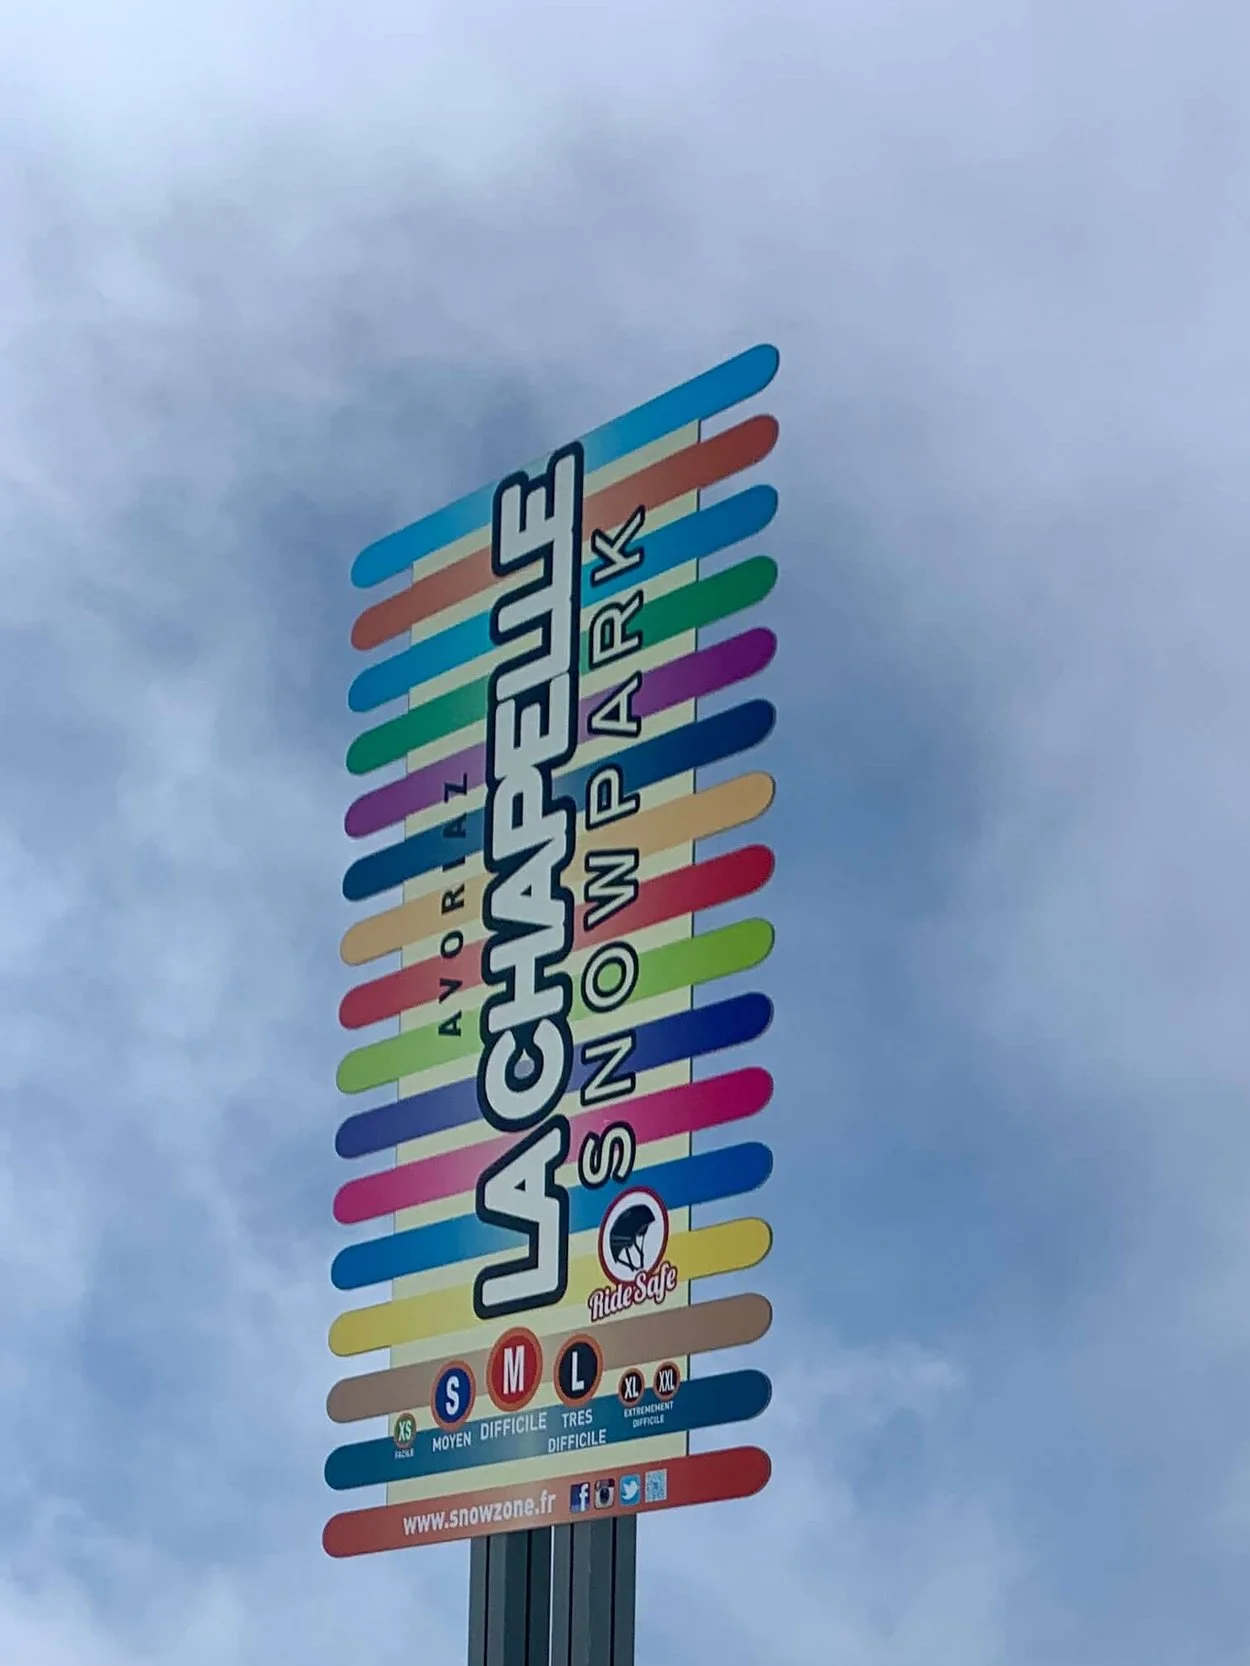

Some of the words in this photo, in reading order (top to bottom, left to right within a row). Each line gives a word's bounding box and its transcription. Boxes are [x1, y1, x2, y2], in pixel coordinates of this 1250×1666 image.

[578, 506, 645, 1188] SNOWPARK
[438, 773, 469, 1037] AVORIAZ
[588, 1286, 632, 1322] Ride
[634, 1261, 677, 1304] Safe
[503, 1345, 525, 1395] M
[571, 1351, 584, 1392] L
[659, 1369, 674, 1393] XXL
[445, 1376, 460, 1416] S
[624, 1376, 639, 1399] XL
[562, 1409, 593, 1428] TRES
[624, 1401, 674, 1418] EXTREMEMENT
[633, 1415, 665, 1428] DIFFICILE
[397, 1420, 412, 1441] XS
[480, 1412, 547, 1438] DIFFICILE
[432, 1432, 472, 1452] MOYEN
[548, 1429, 607, 1453] DIFFICILE
[403, 1489, 556, 1536] www.snowzone.fr
